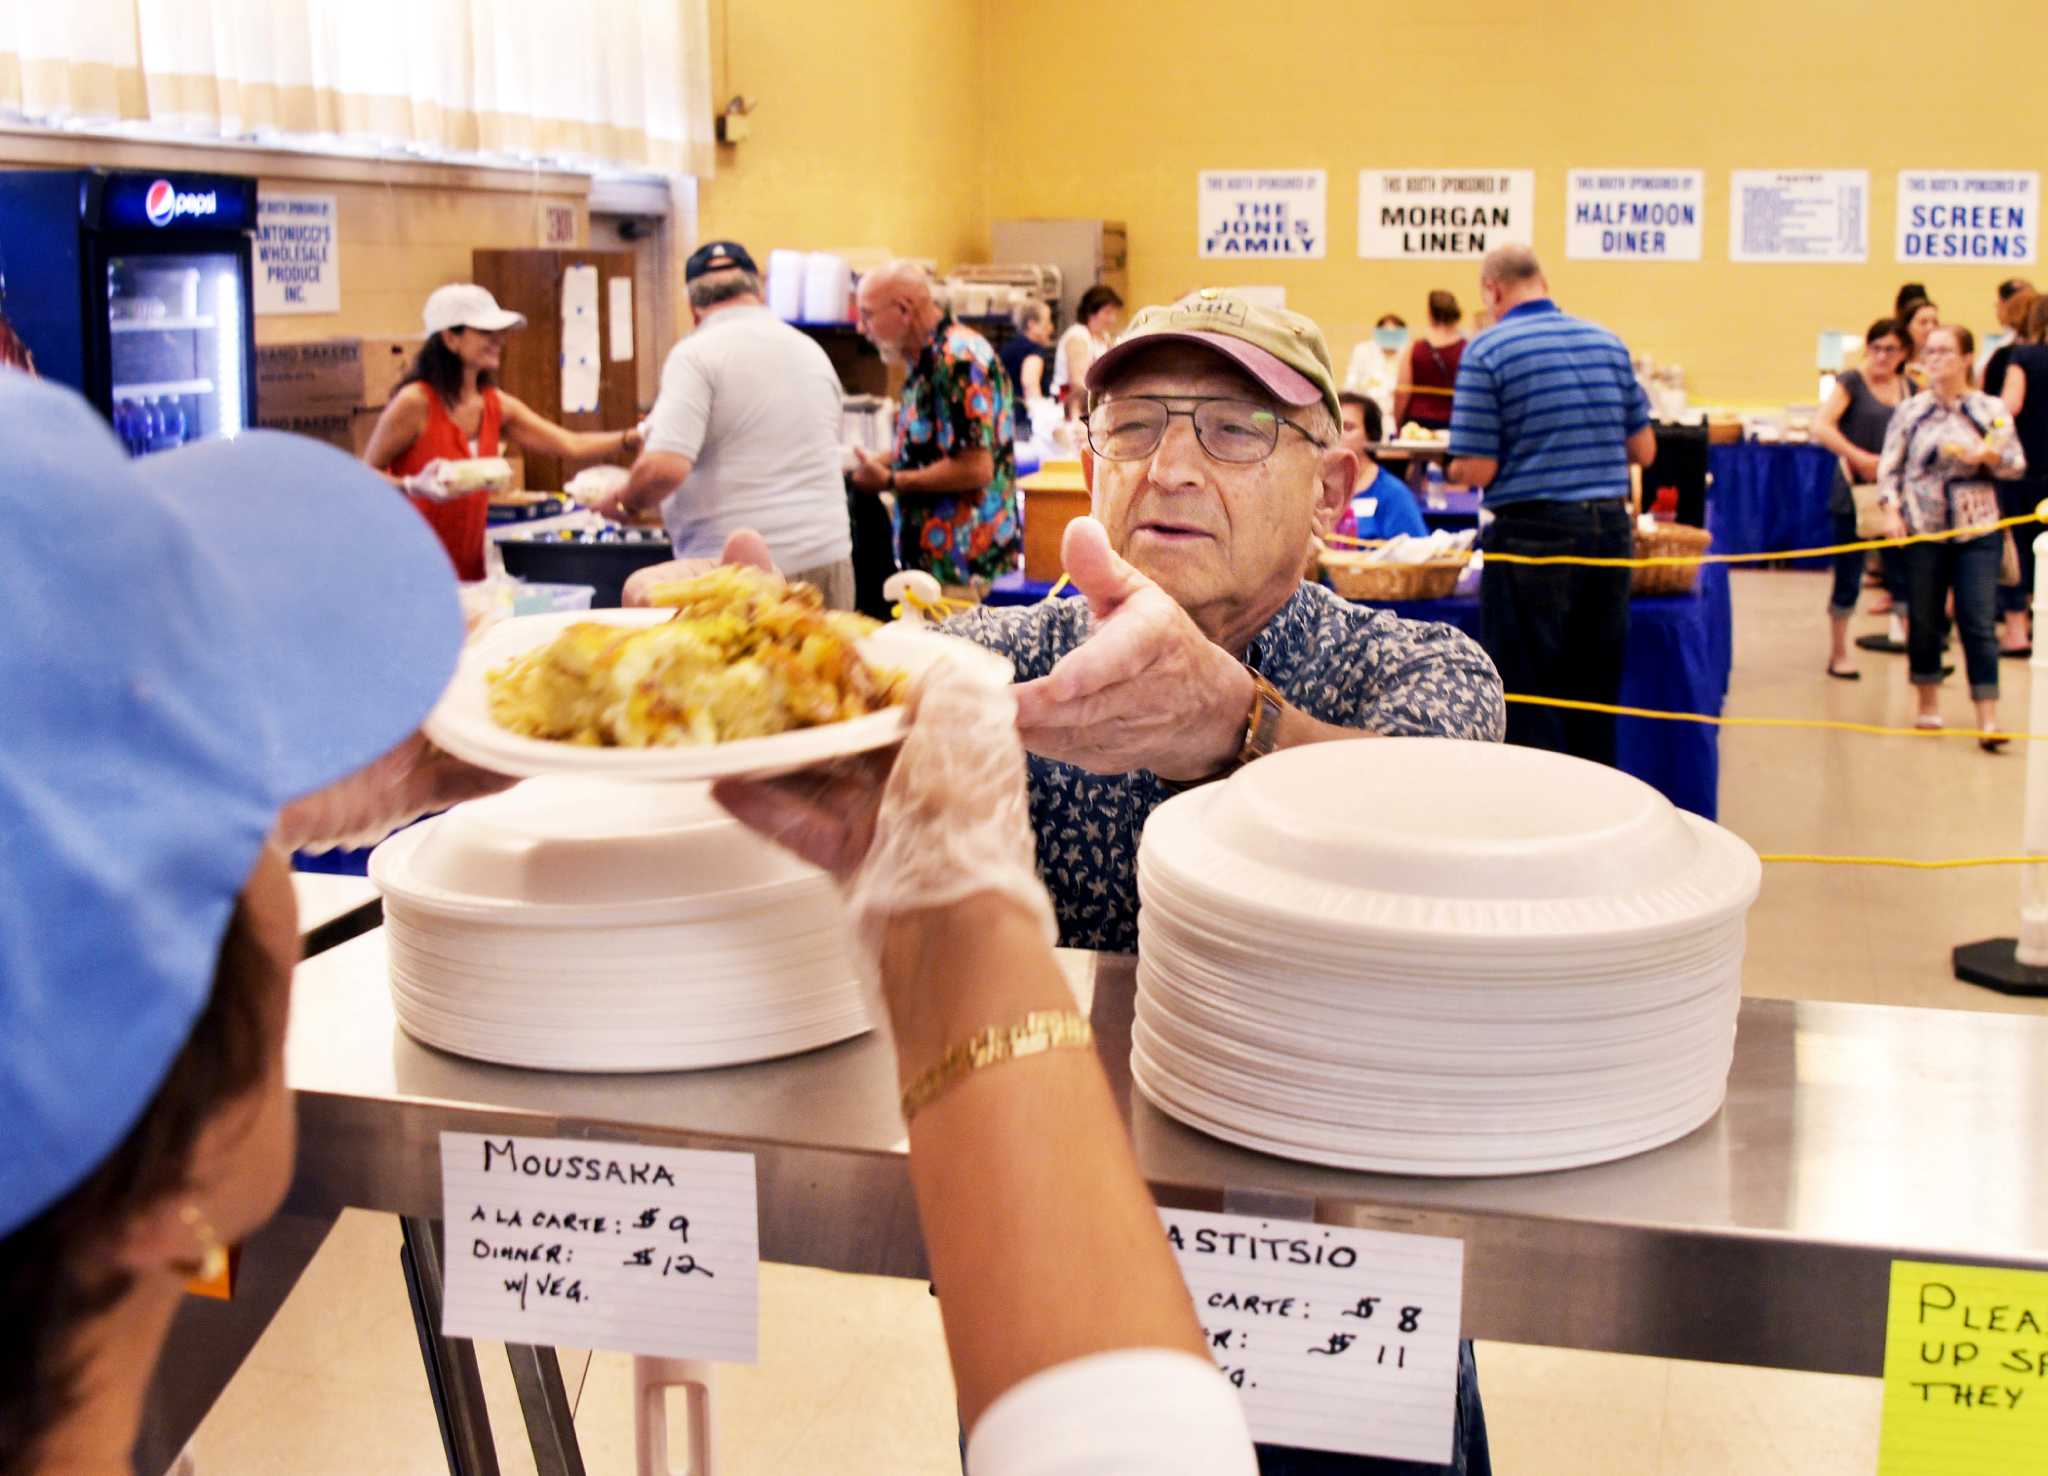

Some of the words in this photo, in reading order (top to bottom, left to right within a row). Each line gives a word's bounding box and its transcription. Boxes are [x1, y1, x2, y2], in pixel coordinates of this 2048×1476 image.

[175, 190, 216, 217] pepsi
[1237, 203, 1286, 216] THE
[1577, 203, 1694, 225] HALFMOON
[1215, 220, 1308, 235] JONES
[1381, 207, 1509, 227] MORGAN
[1911, 205, 2023, 228] SCREEN
[1207, 238, 1315, 252] FAMILY
[1403, 232, 1486, 252] LINEN
[1602, 231, 1665, 253] DINER
[1905, 234, 2028, 257] DESIGNS
[260, 246, 327, 262] WHOLESALE
[267, 266, 320, 282] PRODUCE
[484, 1140, 675, 1187] MOUSSAKA
[471, 1205, 485, 1222] A
[496, 1209, 523, 1228] LA
[1167, 1222, 1357, 1268] ASTITSIO
[1919, 1282, 2046, 1334] PLEA
[1921, 1341, 1979, 1368] UP
[1909, 1381, 2024, 1410] THEY
